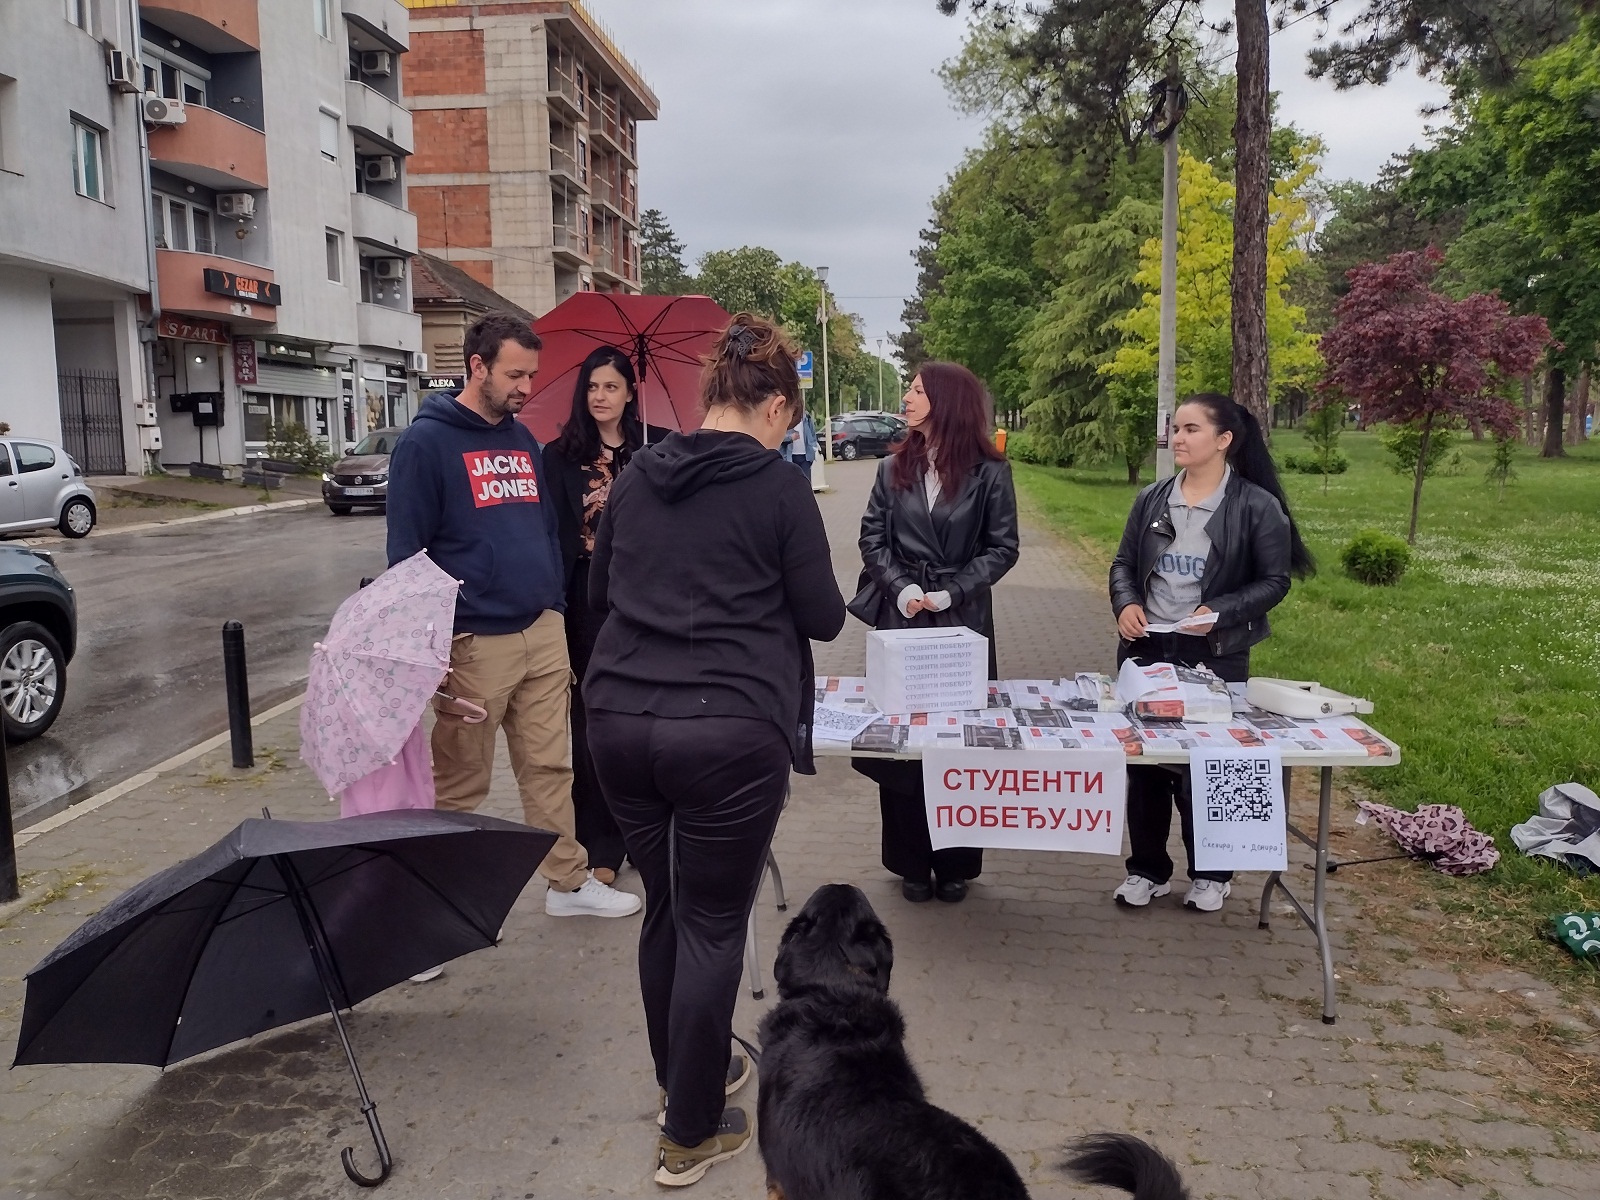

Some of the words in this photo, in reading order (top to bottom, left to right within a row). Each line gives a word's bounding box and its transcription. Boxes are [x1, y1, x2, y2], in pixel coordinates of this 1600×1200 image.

[235, 276, 259, 294] CEZAR
[168, 322, 218, 341] START
[241, 348, 250, 381] START
[428, 379, 456, 388] ALEXA
[472, 455, 532, 476] JACK&
[478, 478, 538, 501] JONES
[904, 644, 939, 652] СТУДЕНТИ
[940, 642, 972, 650] ПОБЕЂУЈУ
[940, 651, 972, 659] ПОБЕЂУЈУ
[940, 661, 972, 669] ПОБЕЂУЈУ
[904, 673, 939, 681] СТУДЕНТИ
[940, 671, 972, 679] ПОБЕЂУЈУ
[904, 683, 939, 691] СТУДЕНТИ
[940, 680, 972, 688] ПОБЕЂУЈУ
[940, 690, 972, 698] ПОБЕЂУЈУ
[904, 702, 939, 710] СТУДЕНТИ
[943, 768, 1103, 796] СТУДЕНТИ
[936, 805, 1111, 833] ПОБЕЂУЈУ!
